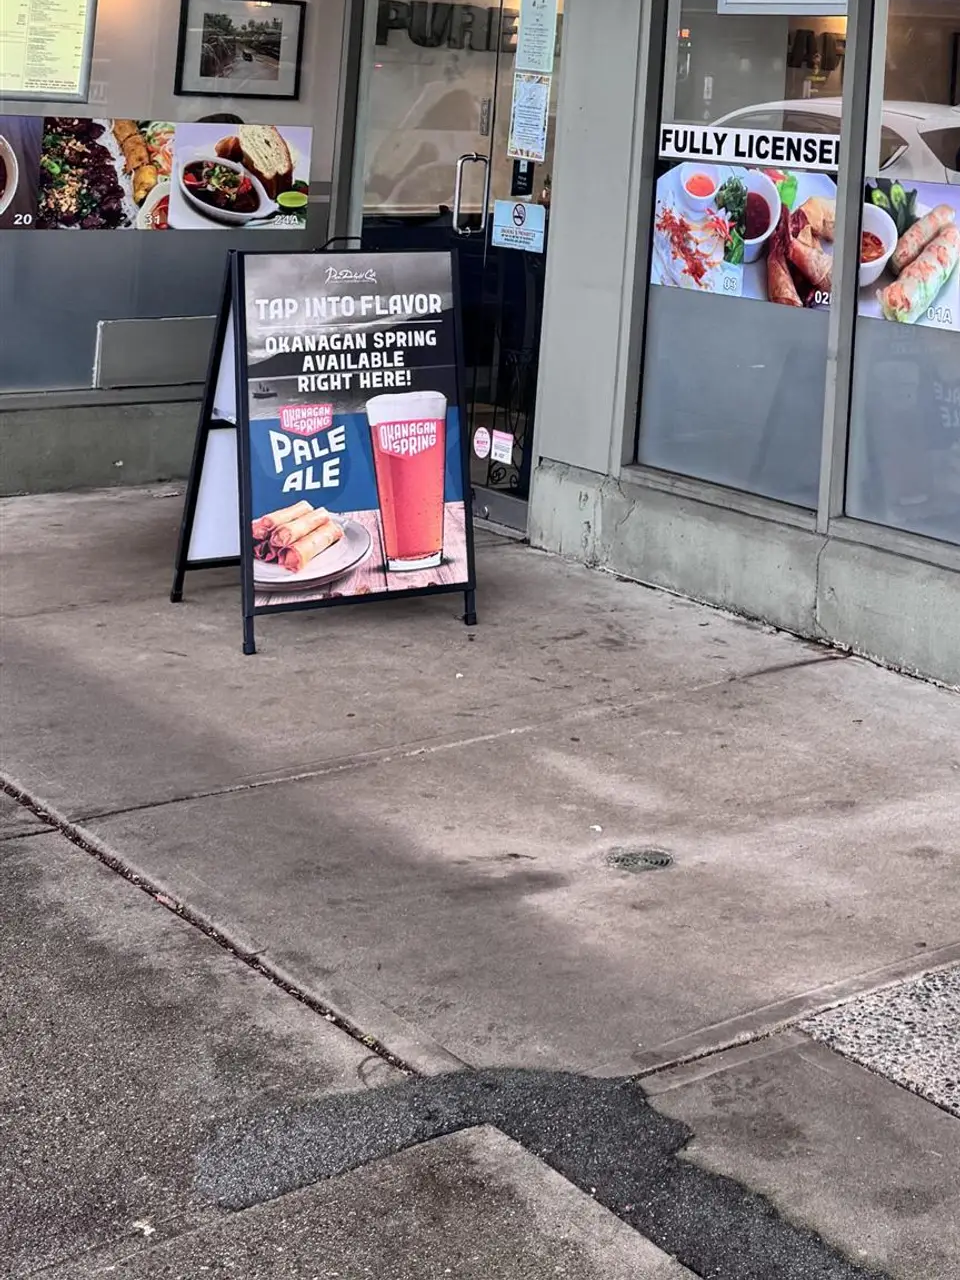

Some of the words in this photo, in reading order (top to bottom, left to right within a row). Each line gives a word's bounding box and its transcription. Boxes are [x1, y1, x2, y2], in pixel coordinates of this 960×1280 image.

[661, 128, 728, 156] FULLY
[13, 213, 32, 225] 20
[146, 213, 160, 225] 31
[255, 297, 298, 320] TAP
[304, 296, 355, 318] INTO
[360, 293, 442, 316] FLAVOR
[814, 290, 832, 305] 02
[926, 306, 953, 324] 01A
[265, 332, 367, 353] OKANAGAN
[373, 329, 437, 349] SPRING
[302, 351, 404, 372] AVAILABLE
[298, 372, 353, 392] RIGHT
[360, 369, 412, 389] HERE!
[282, 406, 331, 428] OKANAGAN
[293, 416, 331, 433] SPRING
[380, 421, 437, 452] OKANAGAN
[393, 434, 437, 457] SPRING
[269, 425, 346, 474] PALE
[282, 457, 340, 493] ALE
